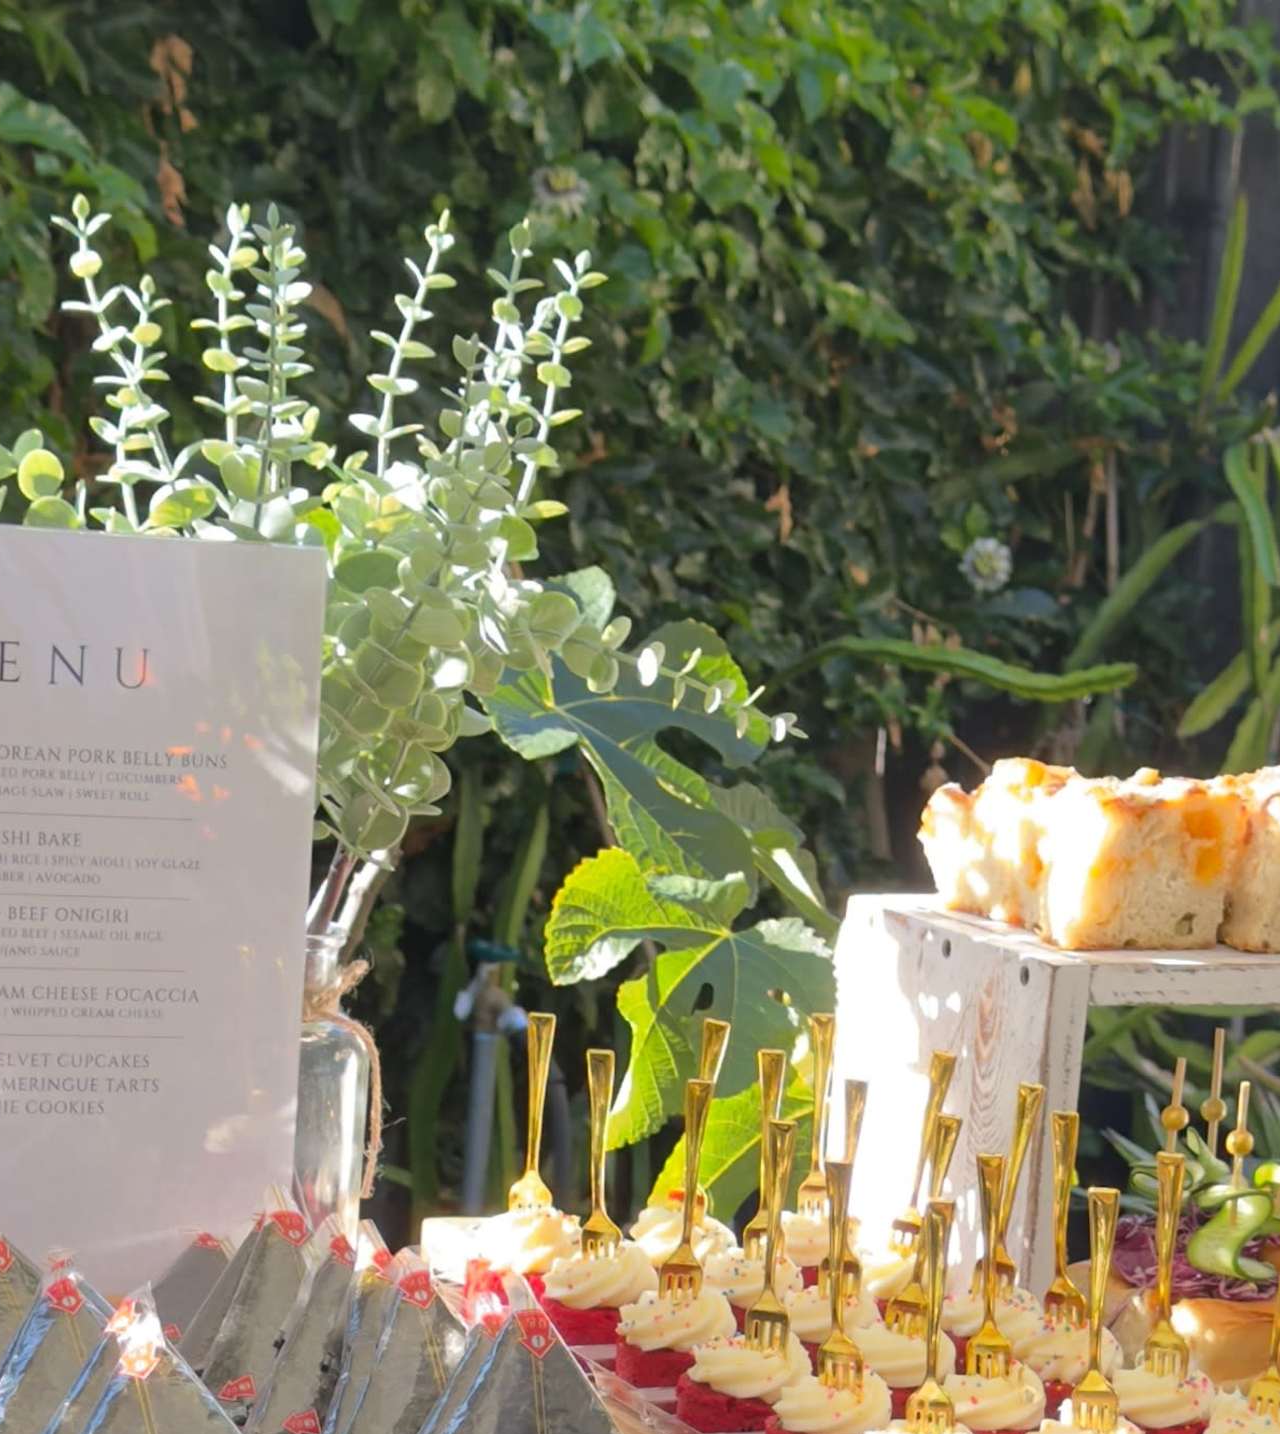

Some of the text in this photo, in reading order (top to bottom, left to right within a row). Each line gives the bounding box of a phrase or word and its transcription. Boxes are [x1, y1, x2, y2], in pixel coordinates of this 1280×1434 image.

[67, 748, 116, 765] PORK
[123, 751, 176, 767] BELLY
[181, 753, 228, 769] BUNS
[22, 767, 55, 780] PORK
[59, 769, 96, 782] BELLY
[106, 772, 184, 785] CUCUMBERS
[31, 786, 64, 799] SLAW
[75, 788, 115, 801] SWEET
[37, 831, 82, 848] BAKE
[11, 853, 41, 866] RICE
[51, 854, 87, 867] SPICY
[161, 858, 201, 872] GLAZE
[36, 872, 102, 886] AVOCADO
[7, 905, 49, 922] BEEF
[54, 907, 130, 924] ONIGIRI
[21, 927, 49, 939] BEEF
[59, 928, 106, 942] SESAME
[109, 929, 131, 942] OIL
[40, 946, 81, 958] SAUCE
[31, 984, 99, 1001] CHEESE
[105, 987, 200, 1004] FOCACCIA
[11, 1006, 68, 1018] WHIPPED
[70, 1007, 115, 1019] CREAM
[56, 1053, 151, 1069] CUPCAKES
[1, 1077, 99, 1093] MERINGUE
[105, 1077, 161, 1094] TARTS
[24, 1100, 105, 1116] COOKIES
